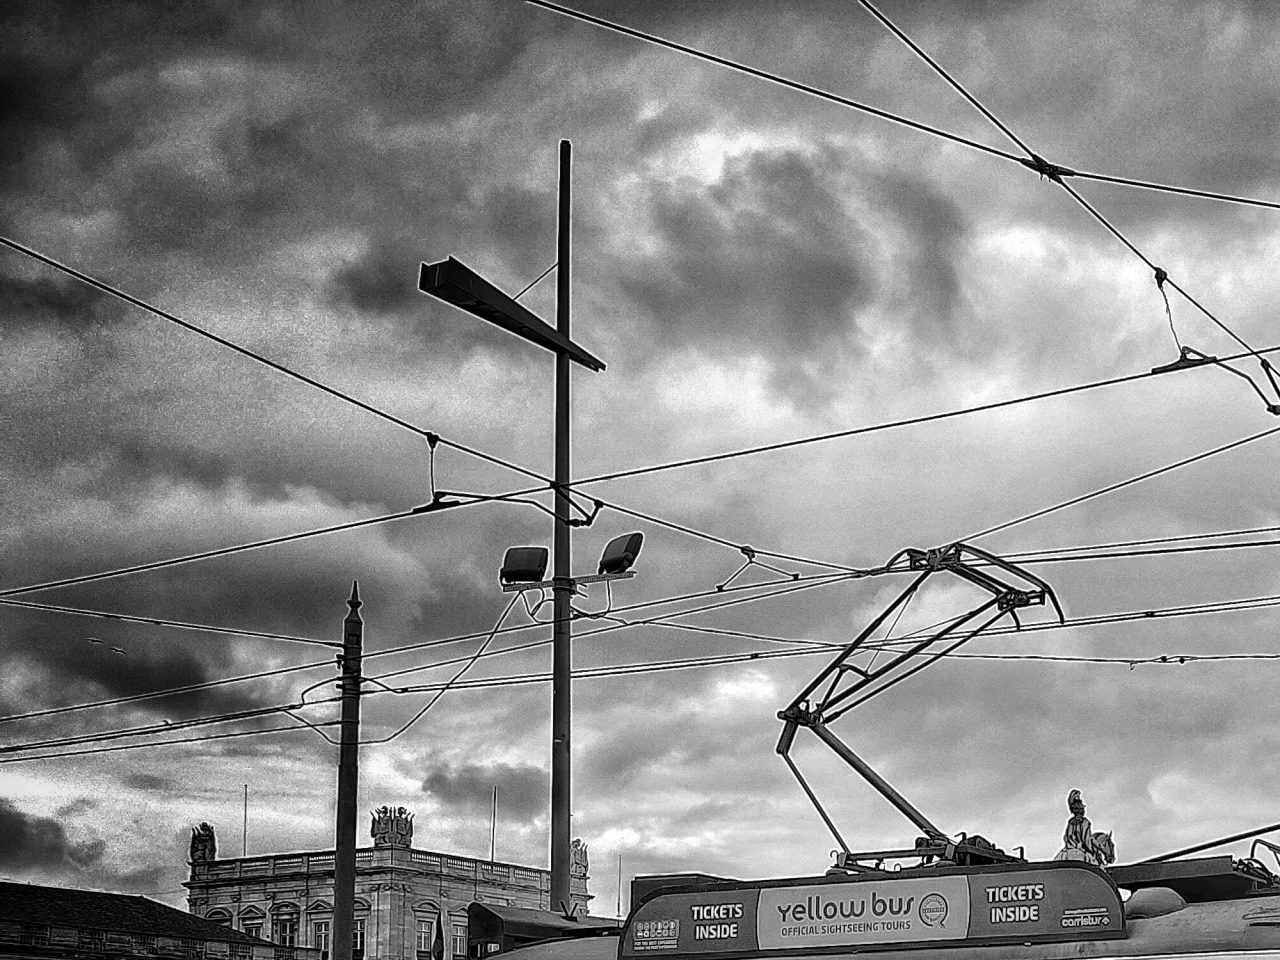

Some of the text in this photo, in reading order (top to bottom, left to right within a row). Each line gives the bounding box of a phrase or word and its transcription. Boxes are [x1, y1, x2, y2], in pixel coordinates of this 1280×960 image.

[985, 884, 1044, 903] TICKETS
[691, 903, 743, 920] TICKETS
[871, 891, 915, 917] bus
[991, 905, 1039, 923] INSIDE
[695, 923, 738, 940] INSIDE
[781, 920, 912, 937] OFFICIAL SIGHTSEEING TOURS
